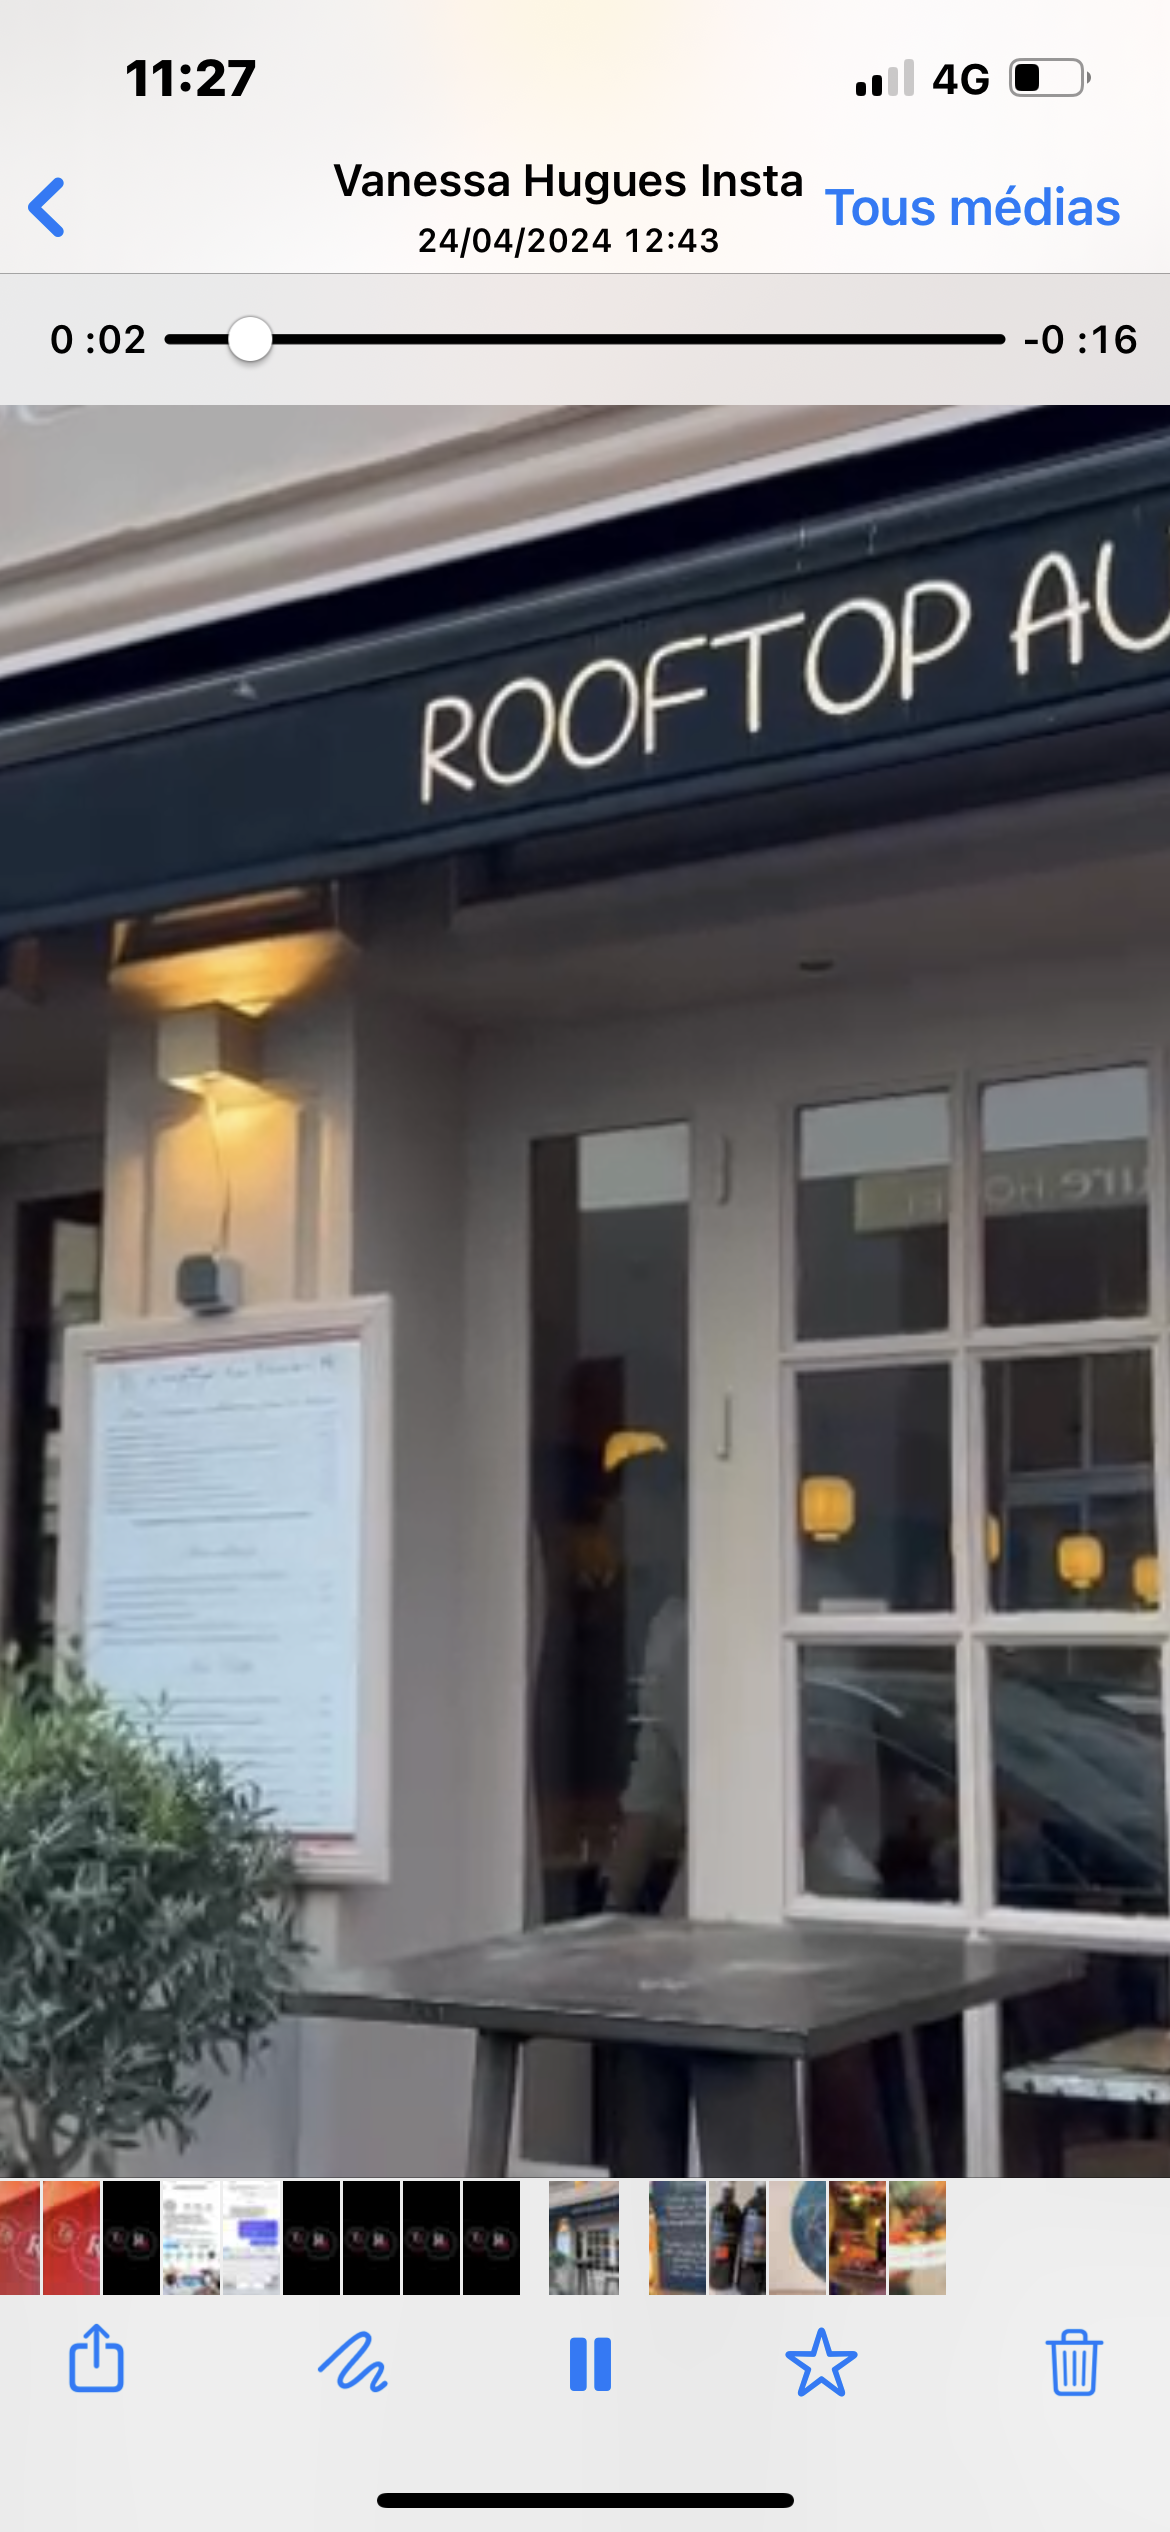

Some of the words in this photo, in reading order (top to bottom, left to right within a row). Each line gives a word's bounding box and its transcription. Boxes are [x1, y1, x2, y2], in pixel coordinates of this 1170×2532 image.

[127, 59, 255, 96] 11:27
[933, 63, 989, 95] 4G
[334, 164, 509, 197] Vanessa
[526, 164, 686, 205] Hugues
[703, 164, 802, 197] Insta
[825, 189, 935, 226] Tous
[952, 185, 1120, 226] médias
[419, 227, 611, 258] 24/04/2024
[626, 228, 718, 253] 12:43
[420, 580, 971, 803] ROOFTOP
[1010, 541, 1170, 675] AU
